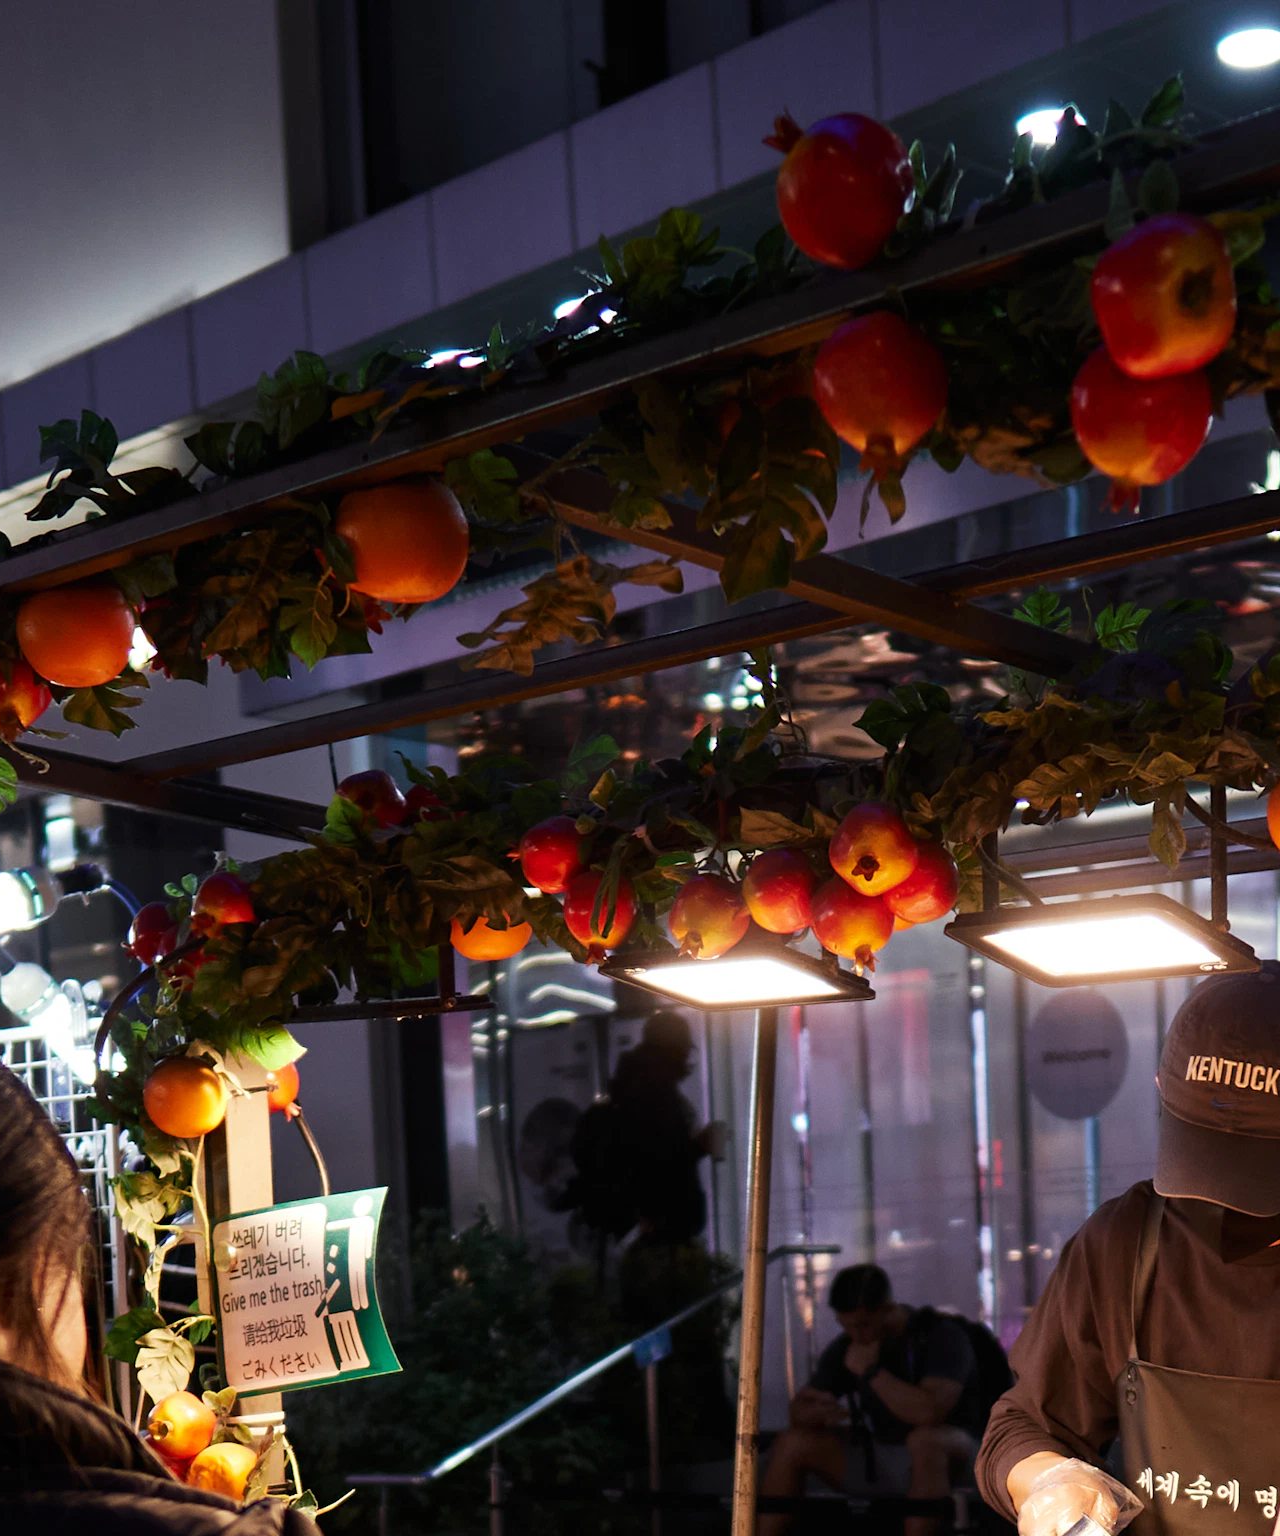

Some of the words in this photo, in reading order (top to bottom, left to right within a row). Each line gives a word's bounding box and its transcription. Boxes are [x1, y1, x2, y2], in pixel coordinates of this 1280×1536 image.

[232, 1222, 269, 1249] 쓰레기
[275, 1217, 302, 1242] 버려
[222, 1291, 246, 1313] Give
[249, 1289, 267, 1308] me
[269, 1281, 289, 1304] the
[242, 1313, 308, 1347] 请给我垃圾
[242, 1352, 322, 1380] ごみください
[1136, 1467, 1179, 1504] 세계
[1185, 1474, 1240, 1512] 속에
